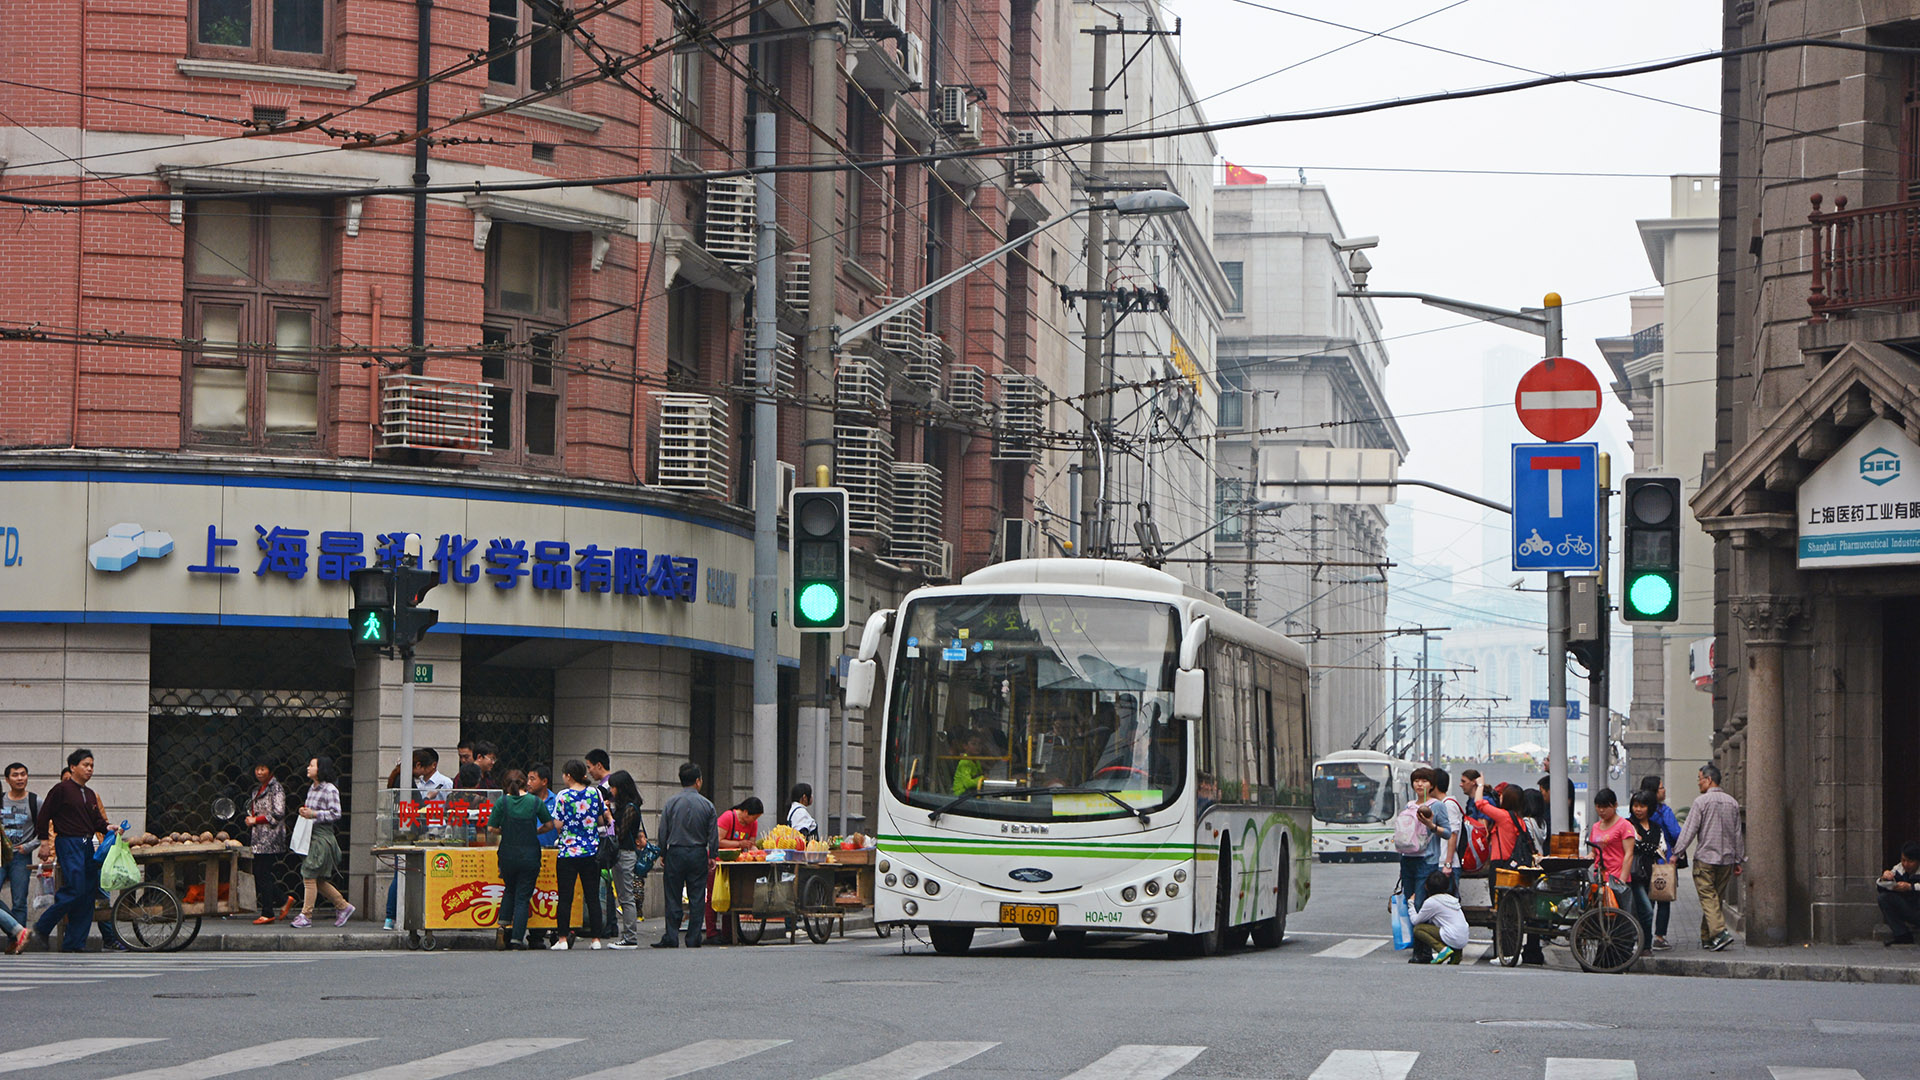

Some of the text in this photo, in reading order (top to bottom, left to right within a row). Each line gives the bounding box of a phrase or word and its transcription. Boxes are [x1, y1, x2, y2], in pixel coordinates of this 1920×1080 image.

[1808, 502, 1920, 524] 上海医药工业有限
[1808, 541, 1837, 554] Shanghai
[1085, 911, 1123, 923] HOA-047
